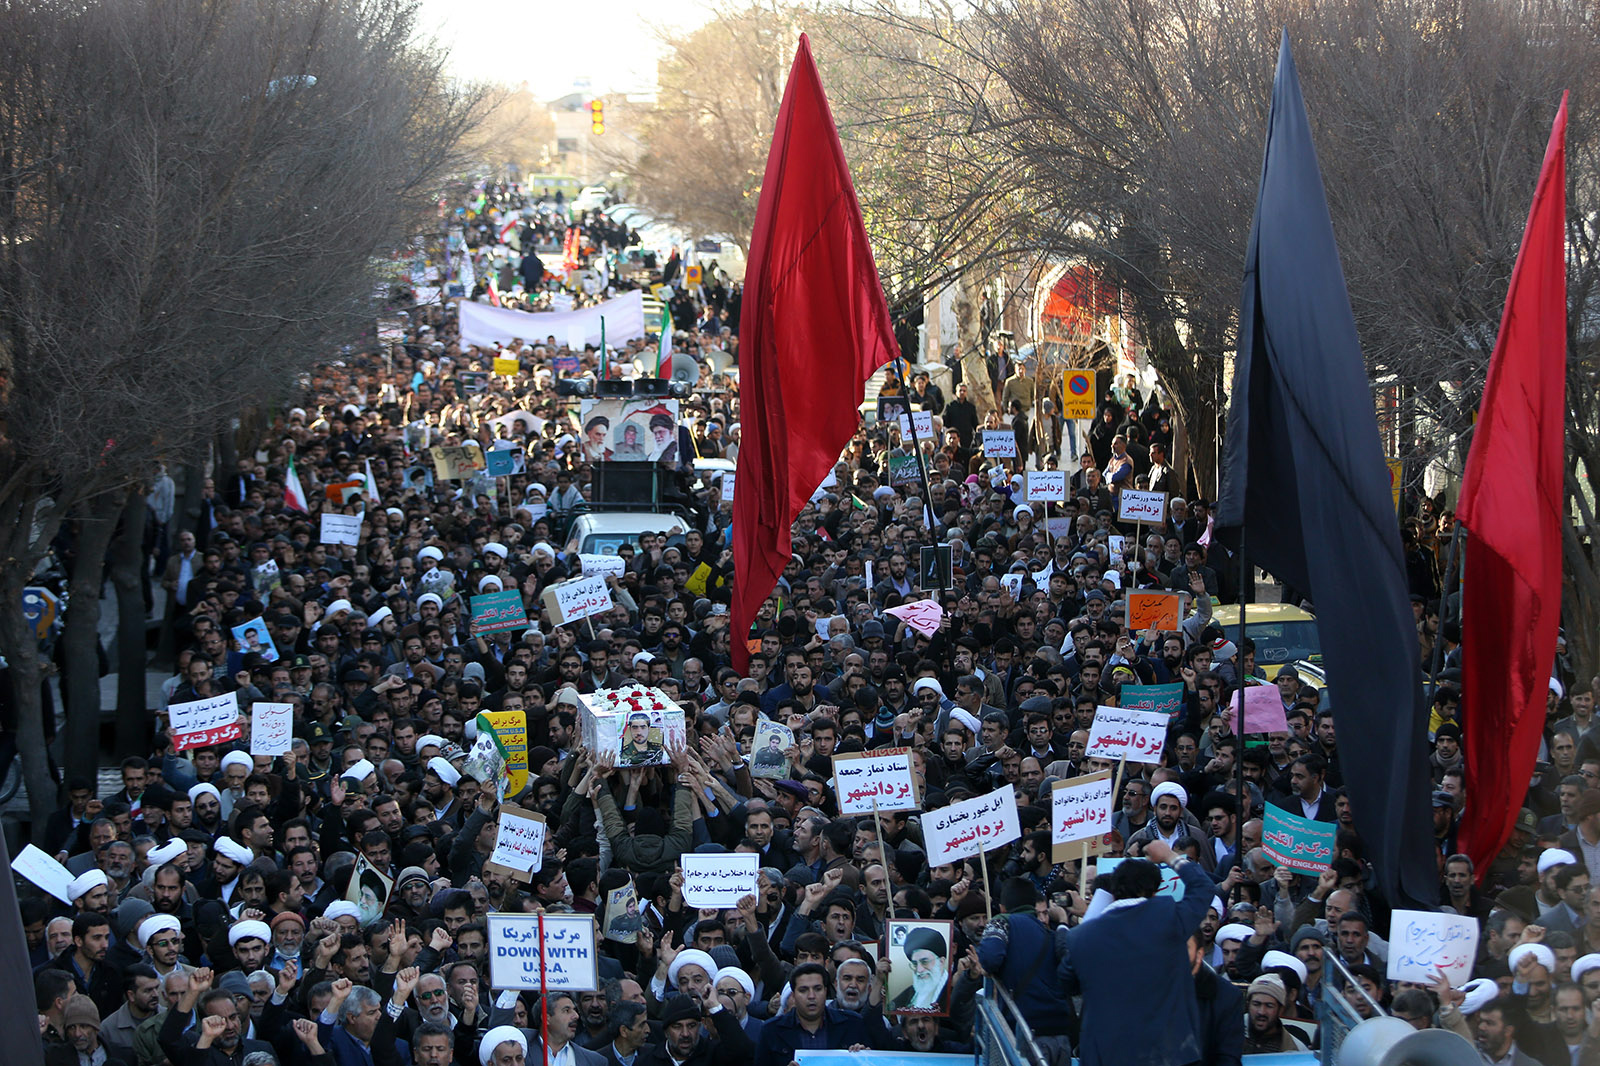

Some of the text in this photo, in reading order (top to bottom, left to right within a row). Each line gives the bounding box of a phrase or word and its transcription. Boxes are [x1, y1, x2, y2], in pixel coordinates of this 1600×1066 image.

[906, 424, 930, 436] یزدار
[987, 445, 1014, 454] یزدانشهر
[1030, 482, 1063, 495] یزدانشهر
[1122, 494, 1148, 502] ورزشکاران
[1126, 504, 1159, 516] یزدانشهر
[572, 586, 587, 600] اسلامی
[588, 581, 602, 593] شورای
[506, 604, 523, 616] مرگ
[567, 595, 608, 617] یزدانشهر
[499, 609, 506, 619] بر
[220, 698, 231, 707] ملت
[1154, 702, 1162, 712] بر
[1163, 698, 1180, 710] مرگ
[177, 707, 191, 716] است
[195, 704, 209, 714] بیدار
[492, 718, 500, 727] امر
[509, 716, 521, 726] مرگ
[1131, 718, 1149, 726] حضرت
[209, 732, 219, 744] بر
[220, 726, 240, 738] مرگ
[512, 735, 523, 744] مرگ
[1090, 730, 1162, 755] یزدانشهر
[512, 753, 525, 762] مرگ
[839, 762, 907, 777] ستاد نماز جمعه
[844, 780, 911, 803] یزدانشهر
[1080, 791, 1092, 803] زنان
[1093, 787, 1110, 800] شورای
[936, 796, 1003, 830] ایل غیور بختیاری
[1060, 808, 1106, 832] یزدانشهر
[943, 820, 1005, 853] یزدانشهر
[1264, 830, 1330, 858] مرگ بر انگلیس
[1276, 856, 1292, 865] WITH
[1292, 860, 1329, 872] ENGLAND
[687, 870, 709, 878] برجام!
[719, 869, 746, 878] اختلاس!
[688, 885, 703, 894] کلام
[503, 926, 538, 942] آمریکا
[553, 928, 581, 943] مرگ
[497, 946, 588, 958] DOWN WITH
[520, 976, 544, 984] مریکا
